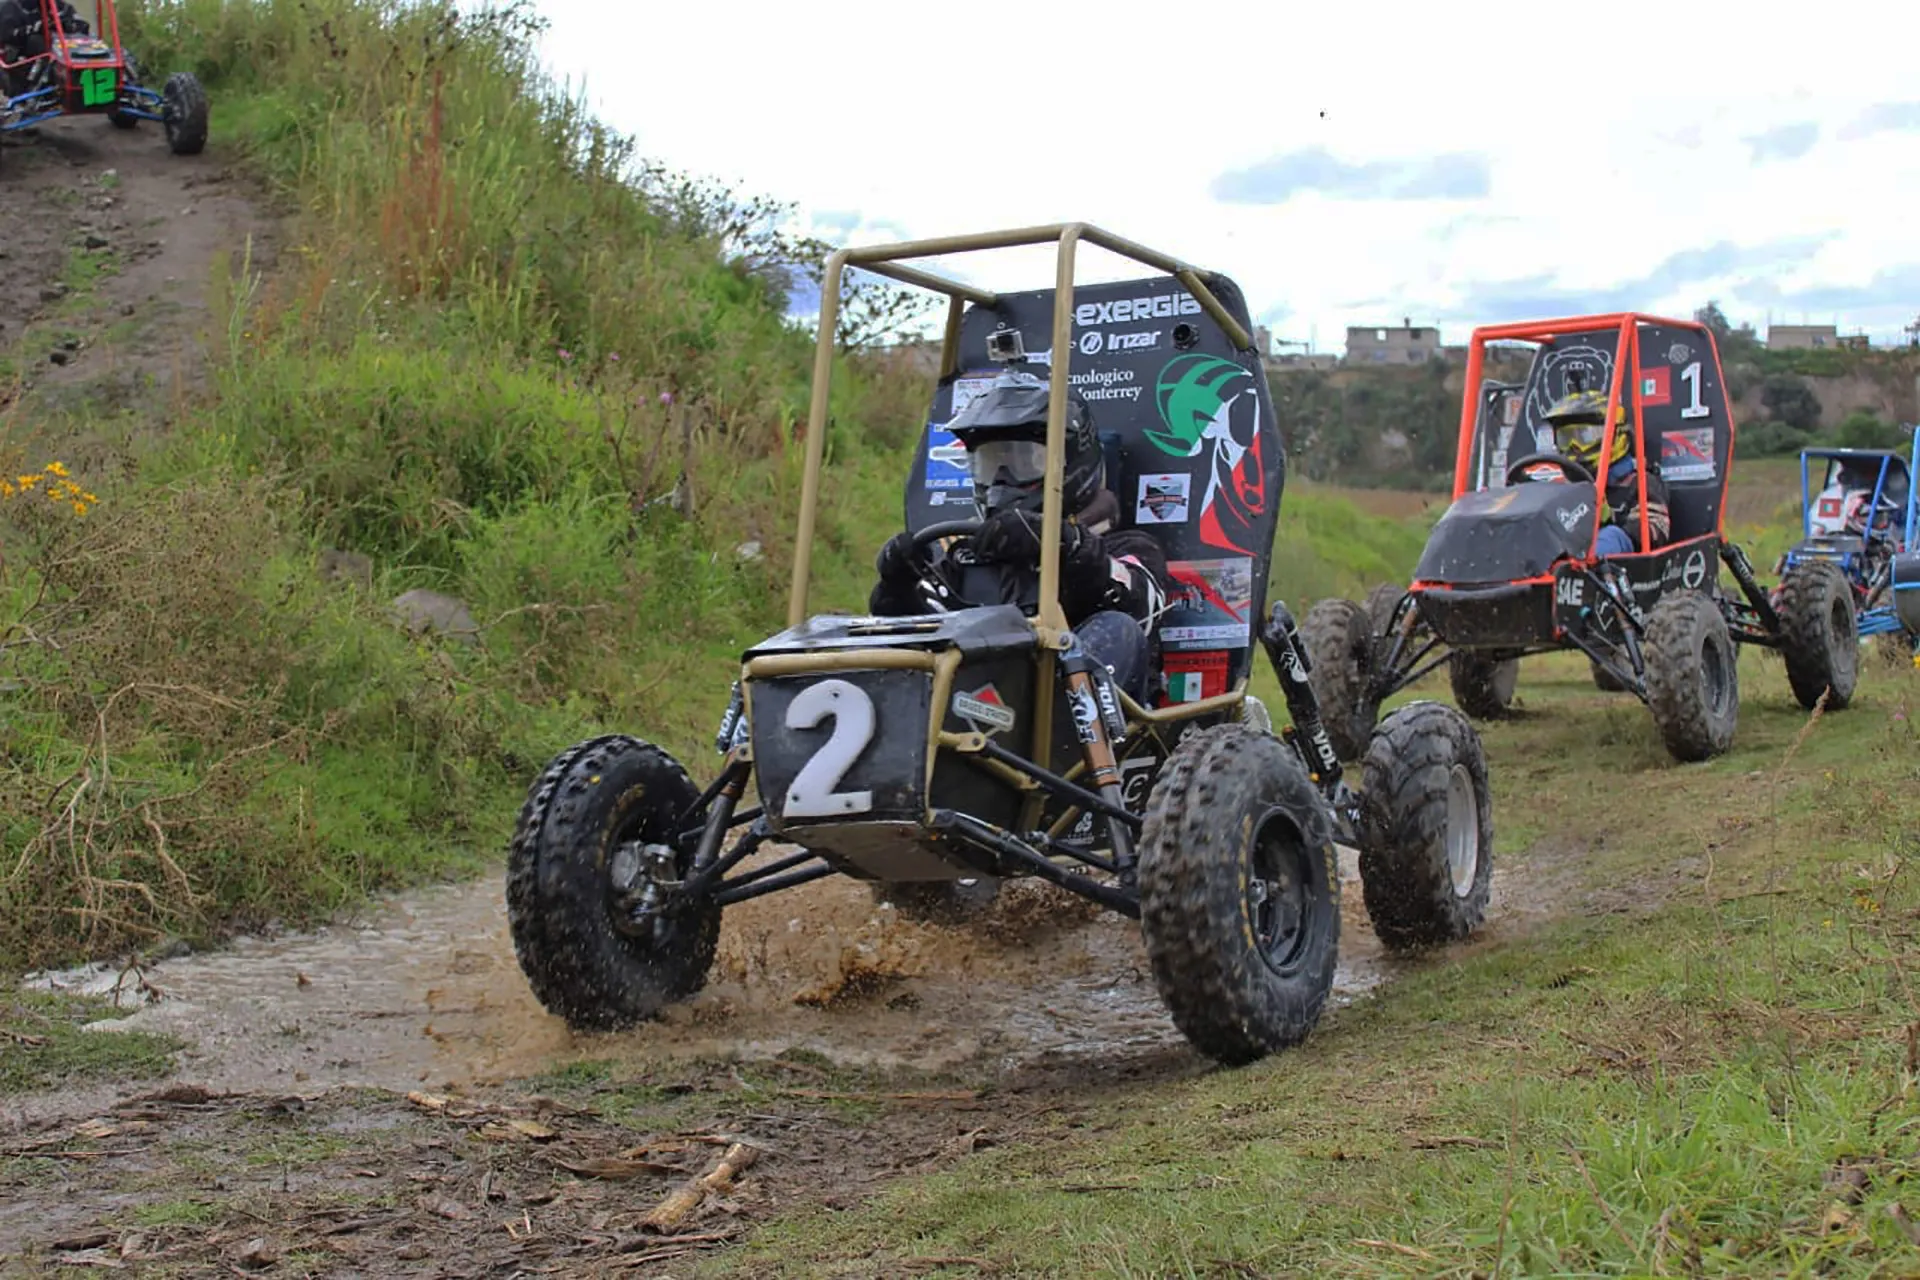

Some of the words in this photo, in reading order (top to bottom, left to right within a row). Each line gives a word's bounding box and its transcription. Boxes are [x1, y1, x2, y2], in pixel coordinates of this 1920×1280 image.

[80, 68, 116, 108] 12
[1681, 362, 1710, 418] 1
[783, 679, 876, 817] 2
